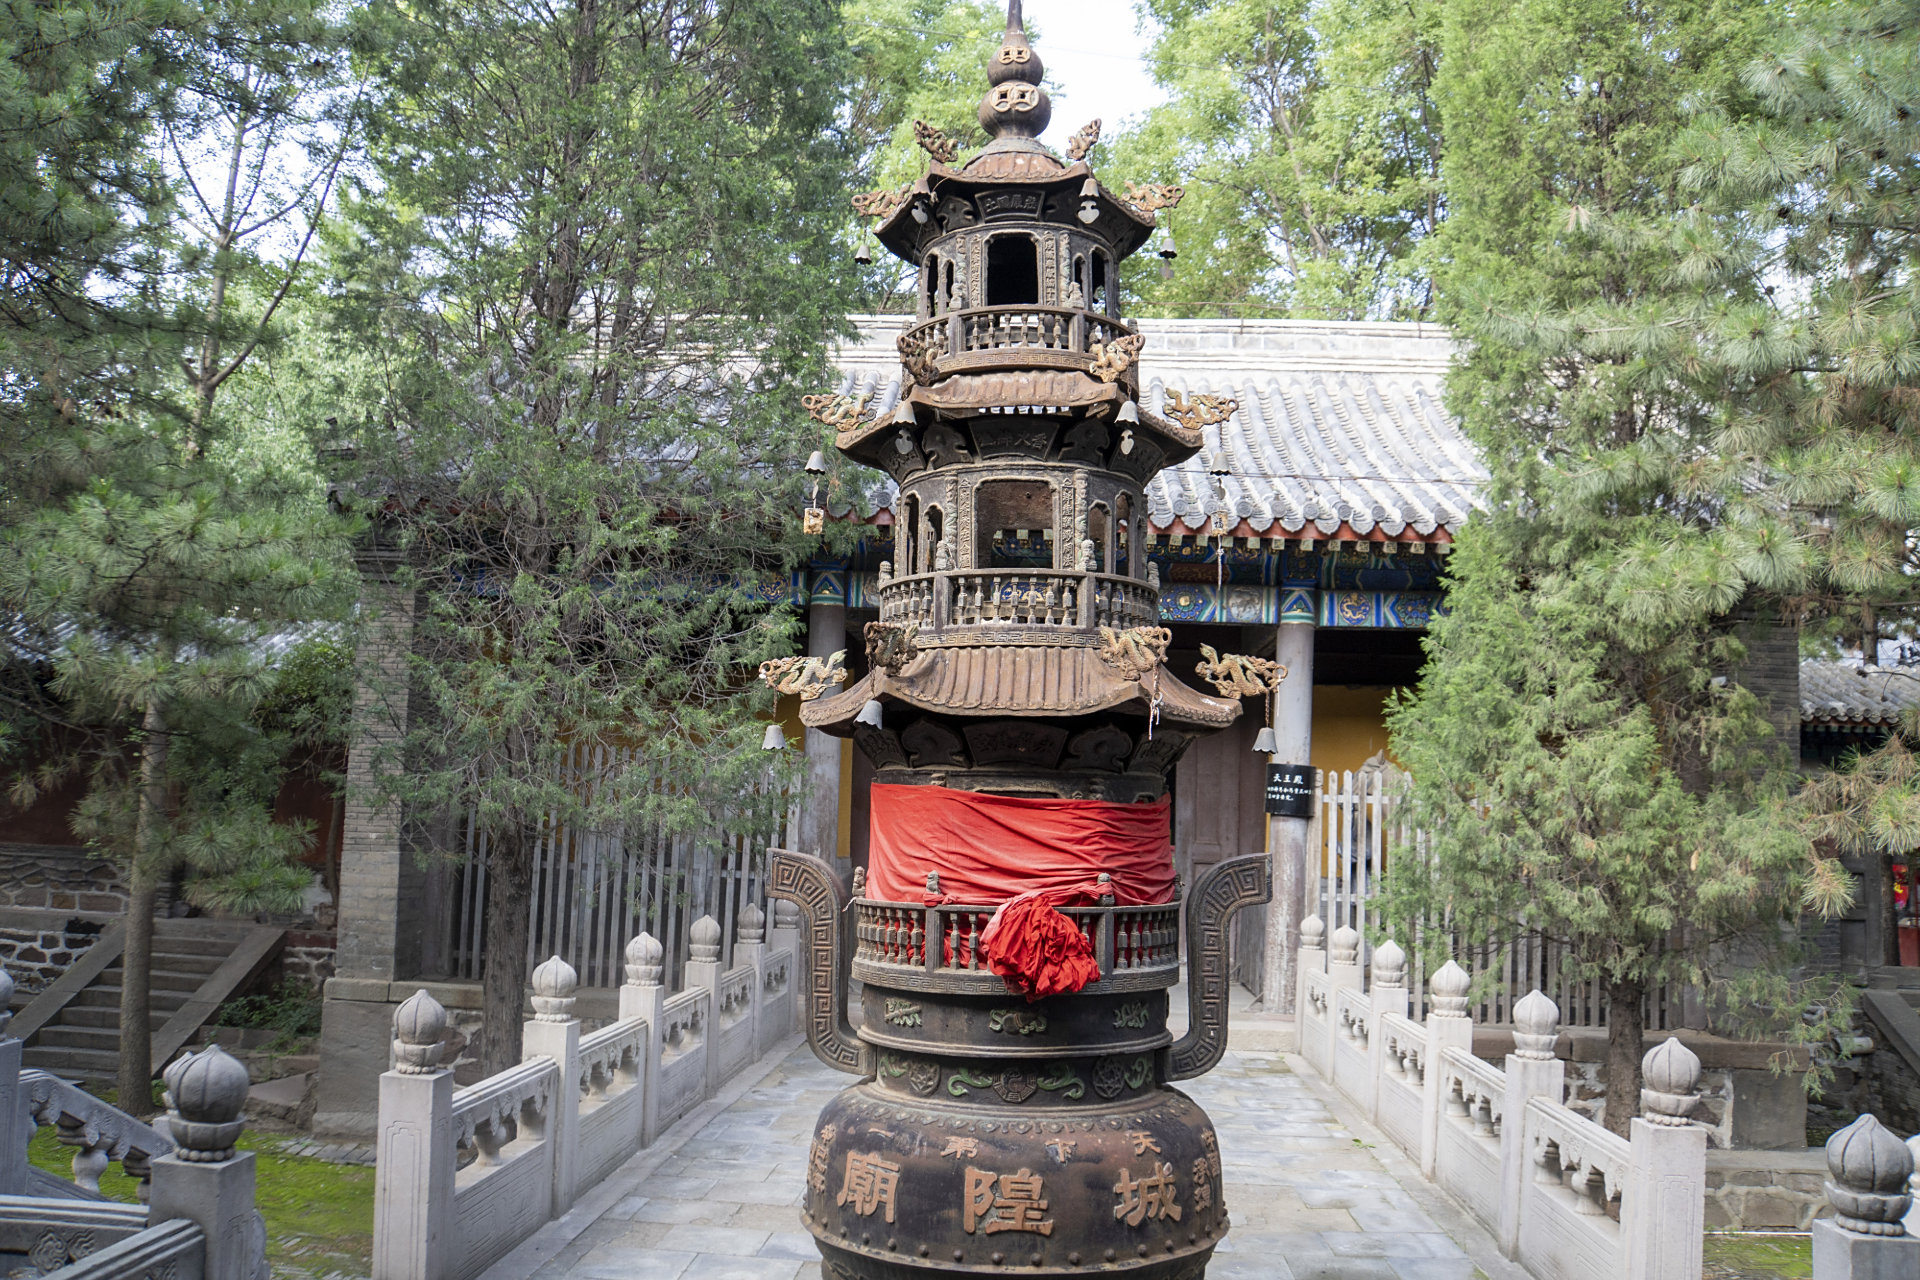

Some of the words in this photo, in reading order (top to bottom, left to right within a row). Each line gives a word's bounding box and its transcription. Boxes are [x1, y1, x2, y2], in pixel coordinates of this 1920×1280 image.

[1273, 773, 1304, 785] 天王殿
[836, 1149, 1183, 1236] 城隍廟
